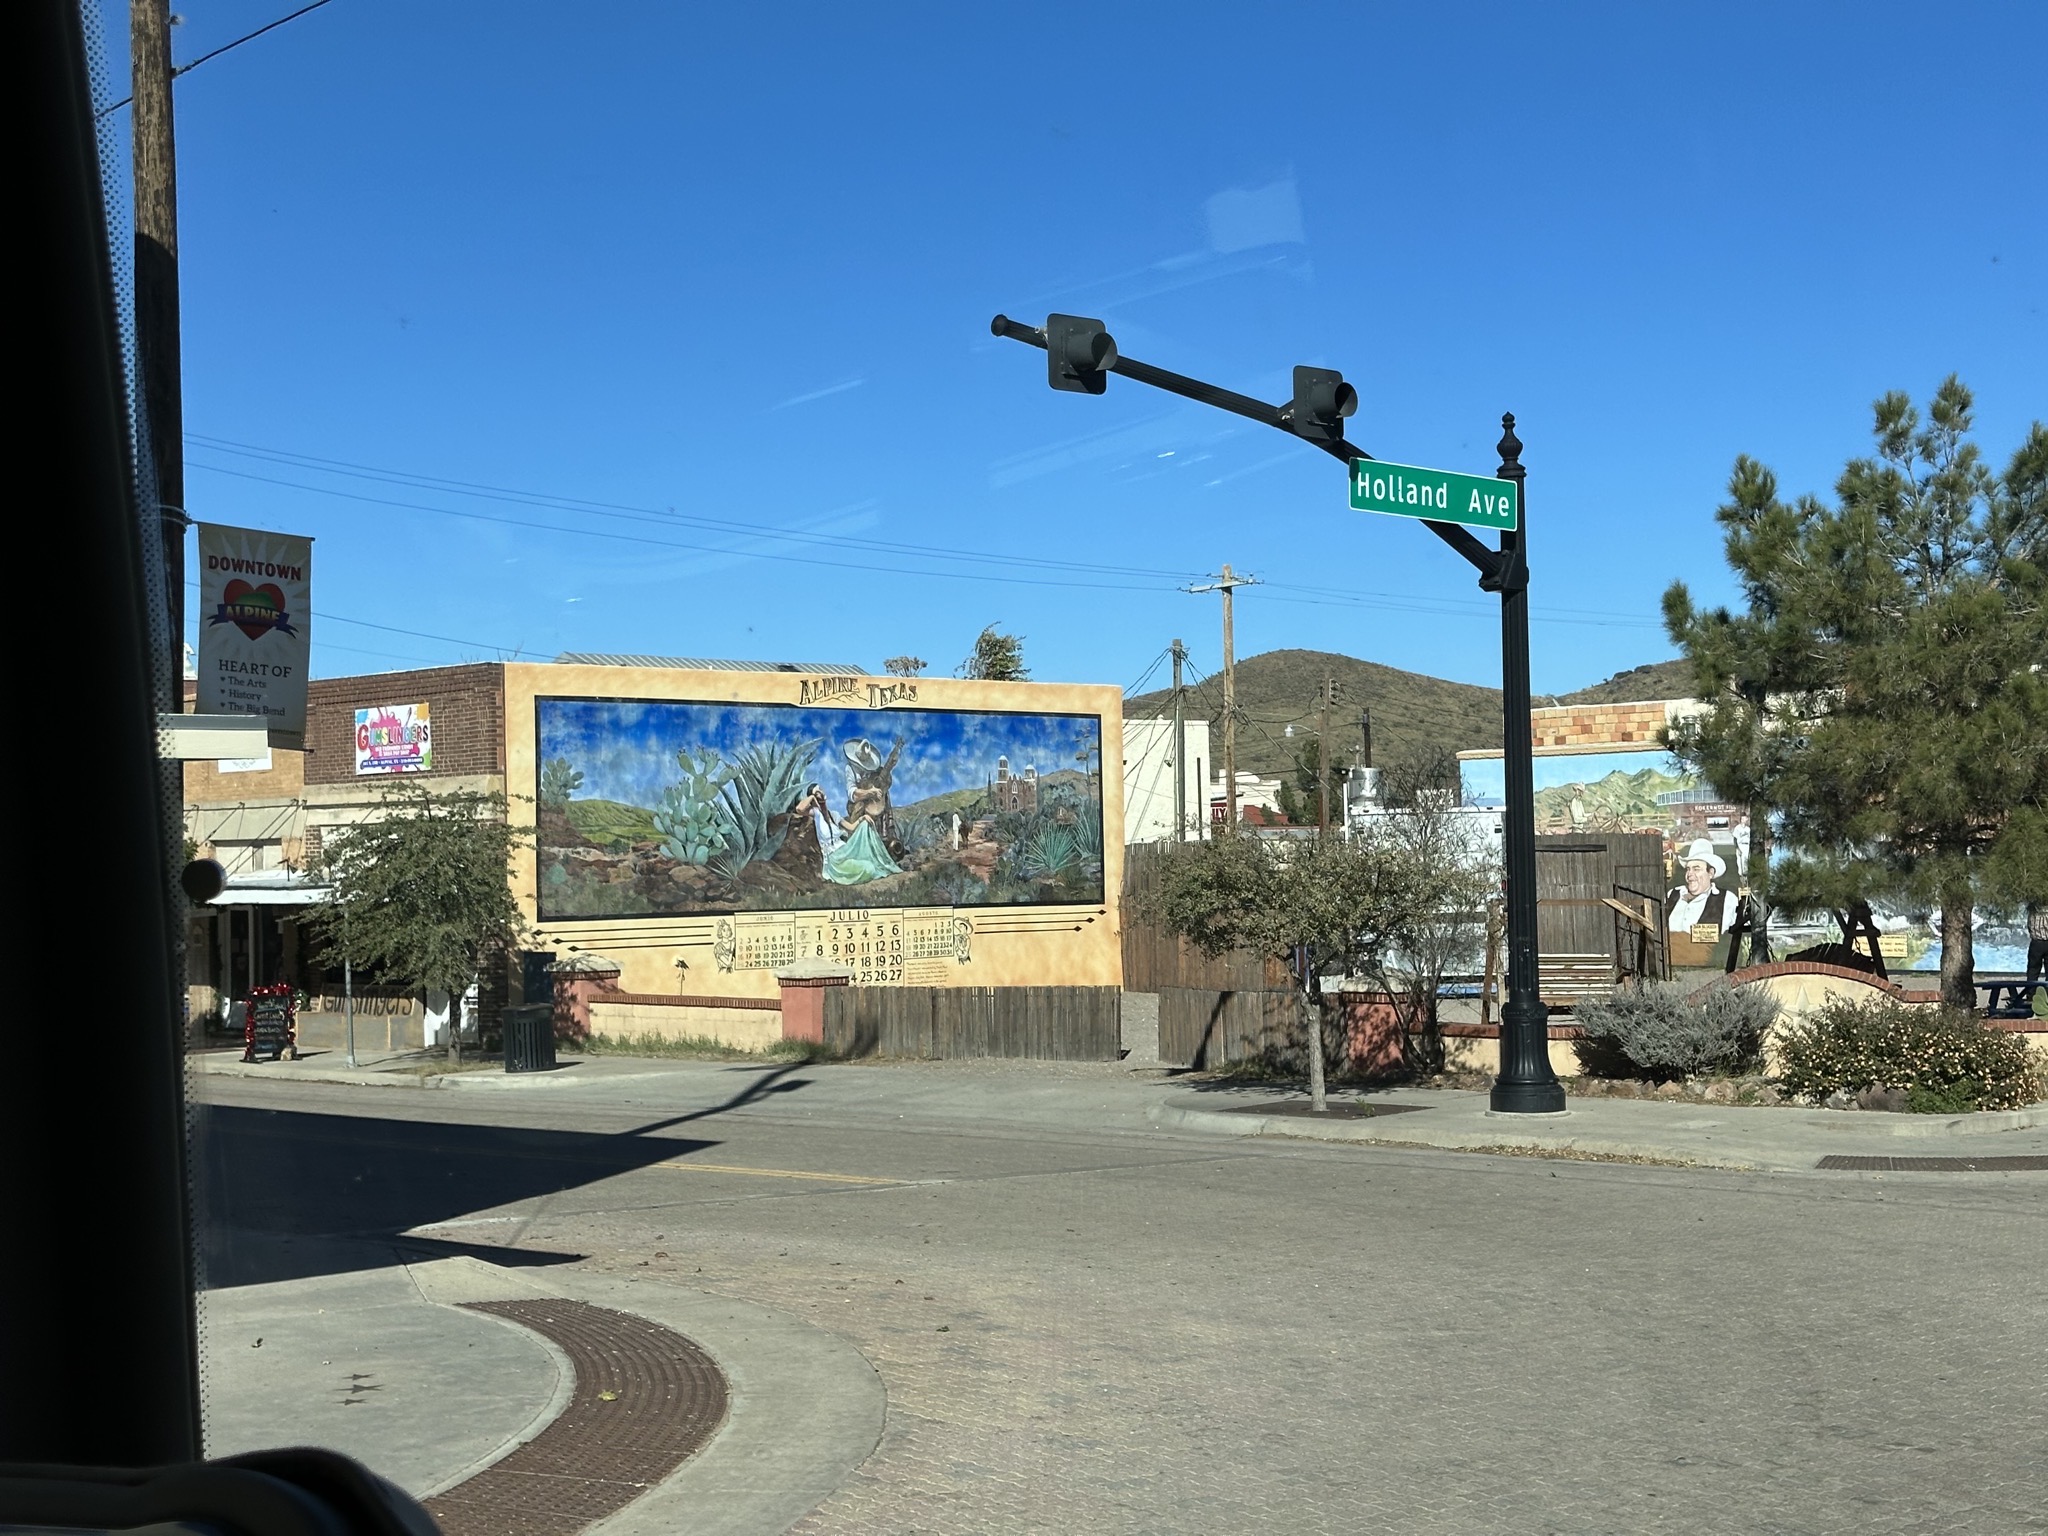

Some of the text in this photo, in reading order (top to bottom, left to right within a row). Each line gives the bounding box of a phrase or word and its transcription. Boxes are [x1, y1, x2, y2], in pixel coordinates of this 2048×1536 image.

[1357, 472, 1510, 516] Holland Ave
[208, 554, 302, 582] DOWNTOWN
[226, 604, 280, 622] ALPINE
[218, 658, 292, 678] HEART OF
[228, 676, 266, 688] The Arts
[228, 689, 262, 702] History
[800, 676, 918, 708] ALPINE TEXAS
[228, 702, 285, 716] The Big Bend
[358, 724, 428, 751] GUMSLINGERS
[830, 910, 869, 921] JULIO
[818, 924, 899, 940] 1 2 3 4 5 6
[816, 945, 823, 956] 8
[832, 944, 839, 954] 9
[845, 943, 855, 954] 10
[861, 942, 870, 953] 11
[875, 940, 885, 952] 12
[891, 940, 901, 951] 13
[845, 958, 855, 967] 17
[861, 956, 871, 967] 18
[875, 955, 885, 966] 19
[889, 954, 902, 965] 20
[860, 971, 872, 982] 25
[874, 970, 888, 981] 26
[889, 970, 902, 980] 27
